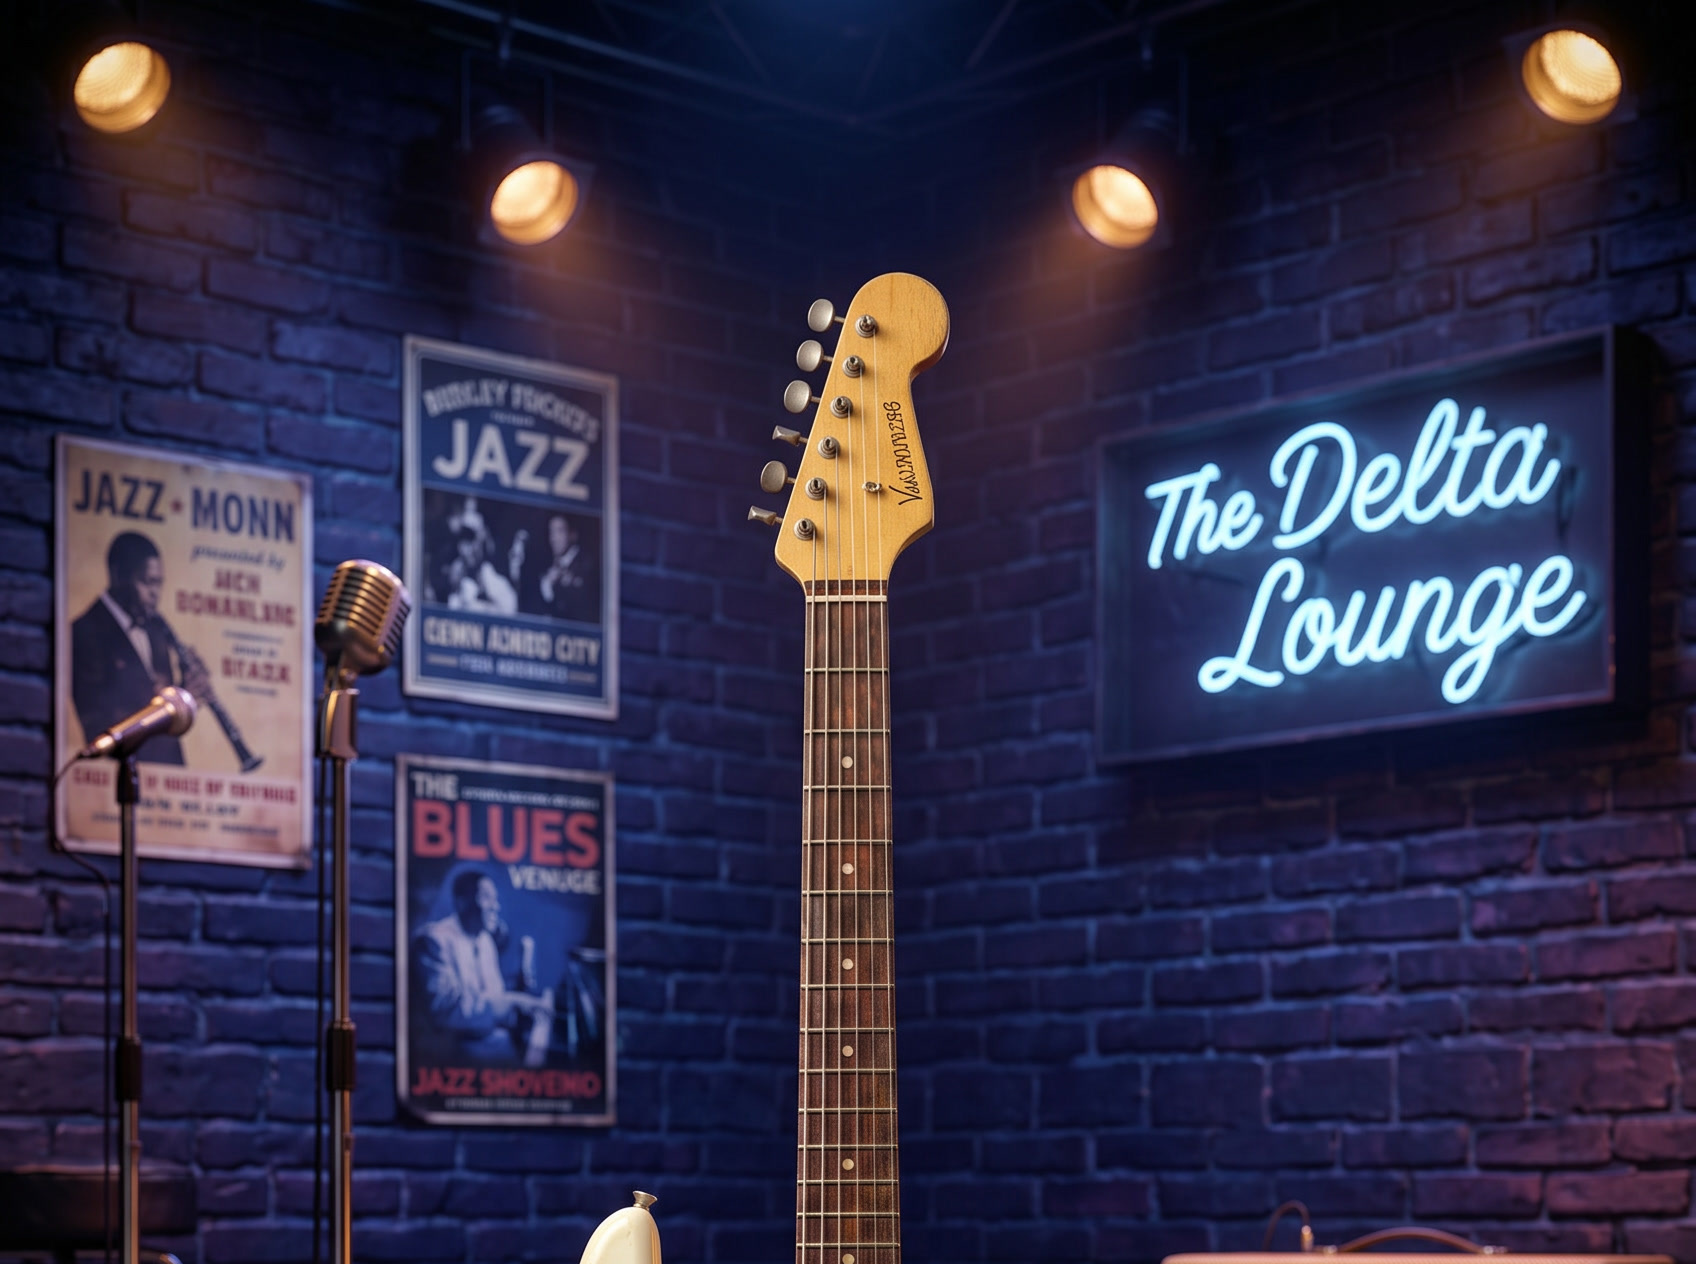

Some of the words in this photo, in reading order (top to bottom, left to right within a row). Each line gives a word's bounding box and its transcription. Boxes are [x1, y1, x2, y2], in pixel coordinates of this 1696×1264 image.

[432, 418, 590, 501] JAZZ
[1145, 463, 1264, 569] The
[1270, 398, 1561, 550] Delta
[74, 468, 165, 523] JAZZ
[190, 486, 296, 545] MONN
[1198, 557, 1587, 704] Lounge
[410, 771, 458, 801] THE
[412, 799, 601, 869] BLUES
[412, 1067, 477, 1097] JAZZ
